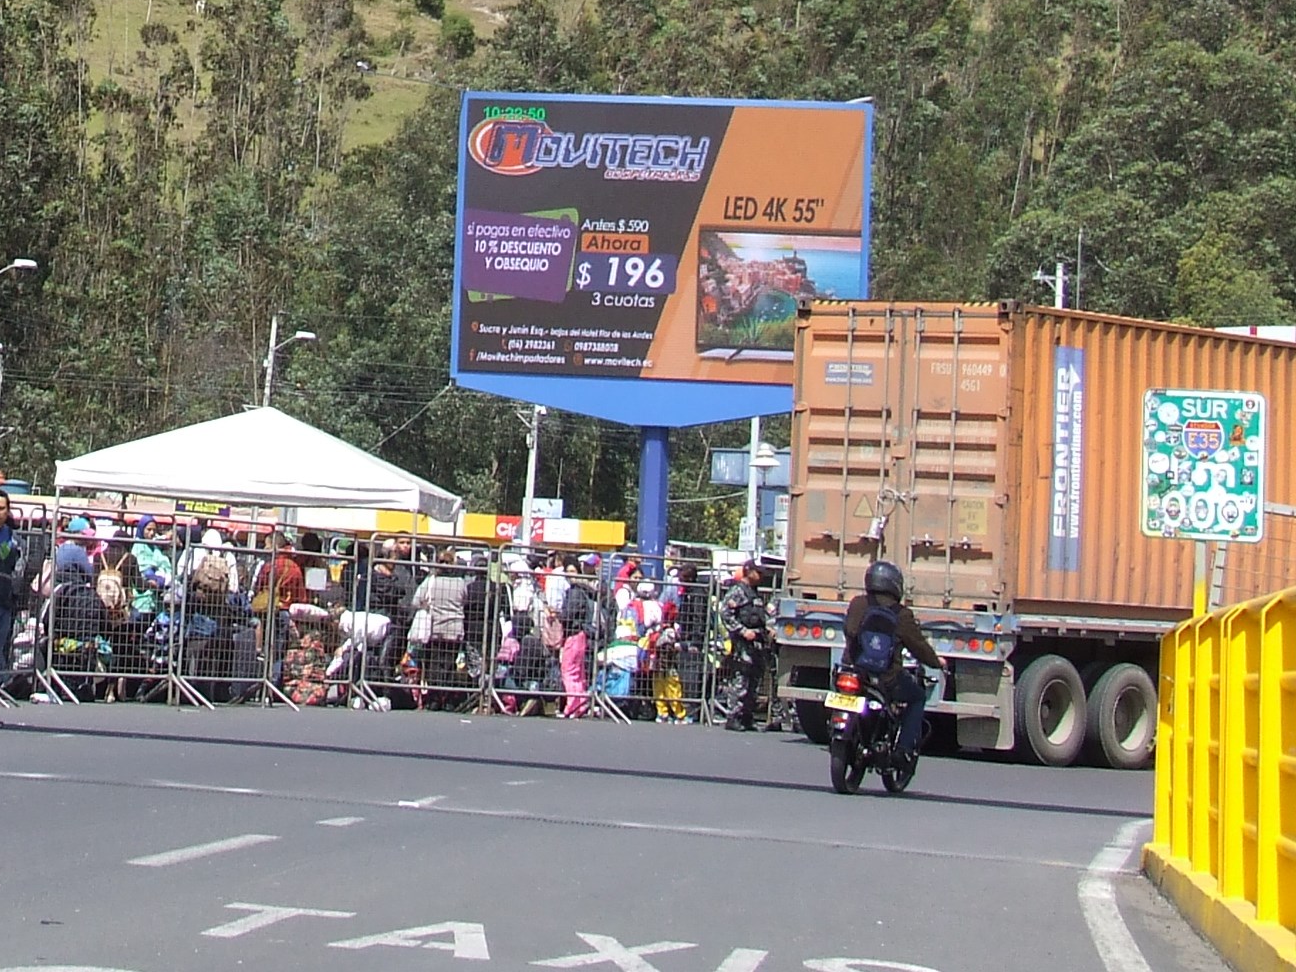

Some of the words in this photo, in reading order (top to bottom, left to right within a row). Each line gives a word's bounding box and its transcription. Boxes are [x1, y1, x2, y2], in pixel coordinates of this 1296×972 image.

[485, 121, 711, 171] MOVITECH
[723, 195, 758, 221] LED
[762, 196, 788, 223] 4K
[475, 224, 510, 238] pagas
[511, 225, 526, 237] en
[528, 224, 571, 239] efectivo
[581, 218, 616, 232] Antes
[626, 219, 649, 233] 590
[475, 239, 486, 253] 10
[500, 240, 562, 256] DESCUENTO
[586, 235, 641, 250] Ahora
[485, 256, 493, 270] Y
[494, 257, 550, 272] OBSEQUIO
[576, 261, 592, 290] $
[608, 257, 664, 288] 196
[591, 291, 601, 306] 3
[604, 293, 655, 308] cuotas
[962, 363, 992, 376] 960449
[1181, 398, 1228, 419] SUR
[1188, 432, 1219, 449] E35
[1054, 367, 1071, 537] FRONTIER
[1070, 391, 1082, 538] www.frontierliner.com
